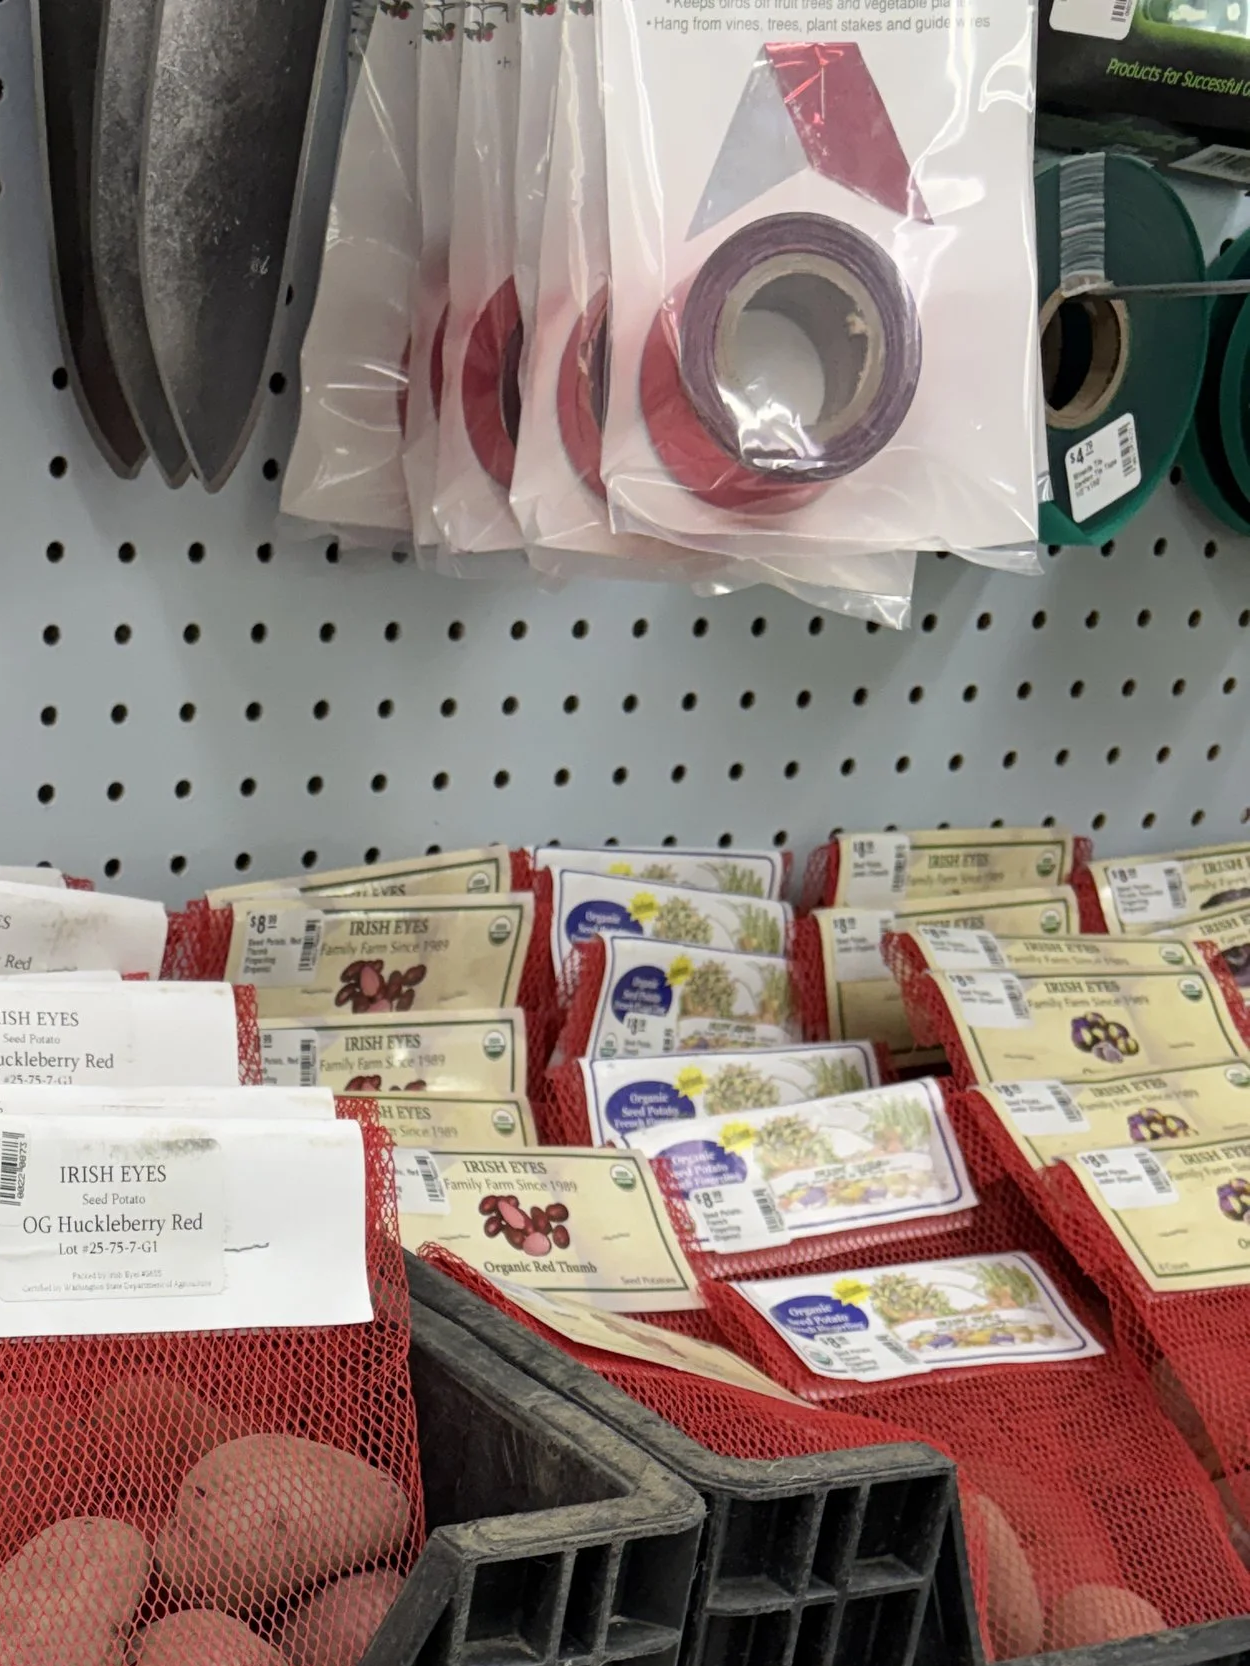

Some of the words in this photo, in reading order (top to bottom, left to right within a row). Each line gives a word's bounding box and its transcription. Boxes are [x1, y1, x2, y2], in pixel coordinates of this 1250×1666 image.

[654, 17, 687, 33] Hang
[693, 18, 721, 31] from
[726, 18, 762, 32] vines,
[767, 18, 802, 33] trees,
[806, 17, 837, 34] plant
[841, 16, 882, 31] stakes
[887, 16, 911, 31] and
[916, 15, 950, 33] guide
[955, 16, 990, 29] wres
[1106, 58, 1162, 82] Products
[1163, 67, 1182, 84] for
[1181, 71, 1241, 94] Successful
[350, 920, 393, 936] IRISH
[394, 919, 429, 934] EYES
[5, 954, 32, 971] Red
[37, 1012, 79, 1026] EYES
[3, 1033, 25, 1044] Seed
[31, 1035, 60, 1044] Potato
[85, 1053, 114, 1069] Red
[630, 1093, 669, 1103] Organic
[622, 1107, 645, 1117] Seed
[648, 1107, 679, 1117] Potato
[60, 1166, 114, 1183] IRISH
[121, 1165, 166, 1182] EYES
[463, 1161, 507, 1174] IRISH
[511, 1162, 547, 1174] EYES
[444, 1179, 481, 1192] Family
[486, 1180, 513, 1191] Farm
[517, 1179, 547, 1191] Since
[550, 1180, 577, 1192] 1989
[83, 1193, 108, 1205] Seed
[112, 1194, 145, 1205] Potato
[23, 1216, 51, 1234] OG
[58, 1214, 166, 1236] Huckleberry
[172, 1212, 202, 1230] Red
[59, 1243, 77, 1255] Lot
[82, 1241, 157, 1254] #25-75-7-G1
[484, 1261, 531, 1276] Organic
[535, 1262, 556, 1273] Red
[559, 1262, 597, 1274] Thumb
